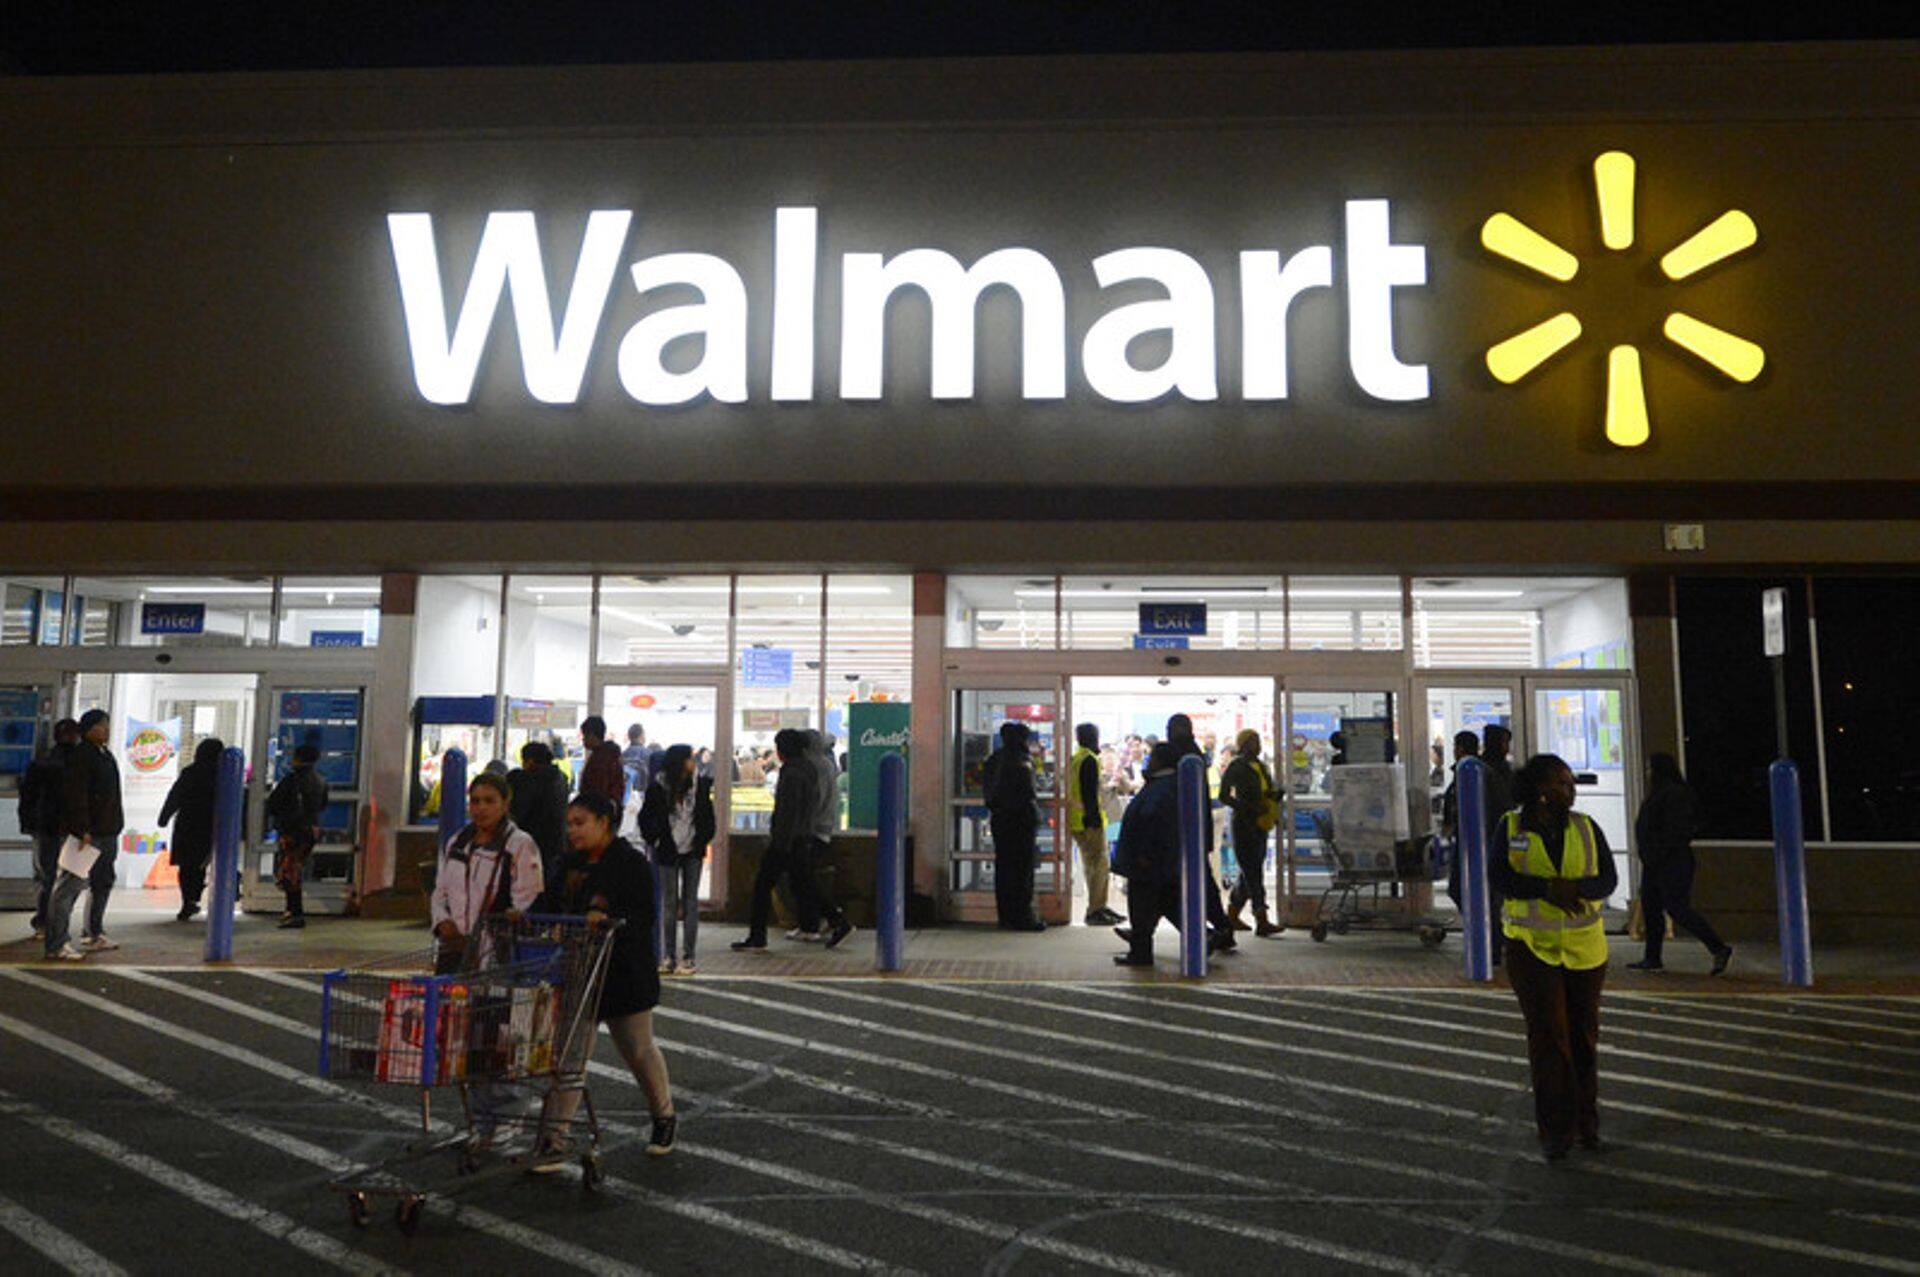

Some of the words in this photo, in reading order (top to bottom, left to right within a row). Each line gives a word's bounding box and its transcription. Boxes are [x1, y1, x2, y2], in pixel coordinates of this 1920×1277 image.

[387, 200, 1430, 405] Walmart
[147, 607, 195, 629] Enter
[1153, 609, 1191, 629] Exit
